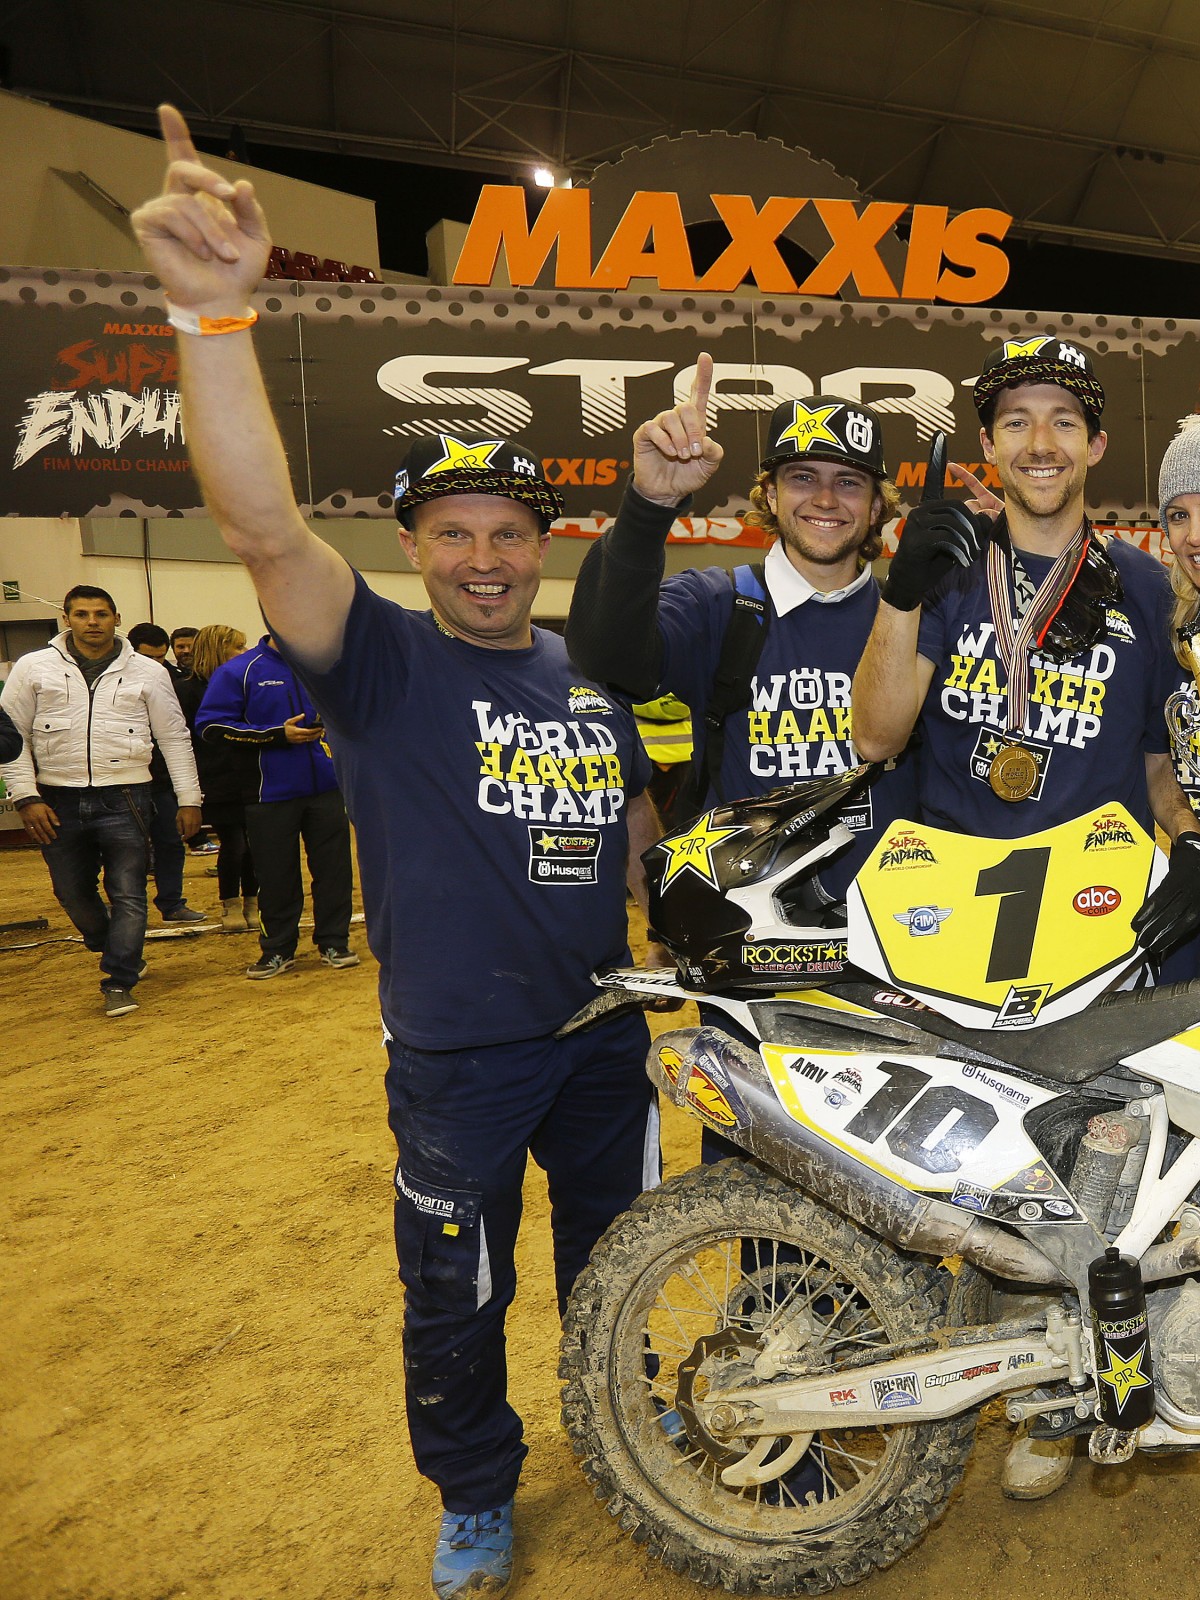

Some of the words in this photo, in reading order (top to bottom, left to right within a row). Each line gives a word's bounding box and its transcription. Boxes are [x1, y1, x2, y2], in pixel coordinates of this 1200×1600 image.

[453, 185, 1011, 302] MAXXIS
[103, 322, 174, 337] MAXXIS
[50, 339, 178, 393] SUPE
[377, 354, 985, 443] STAR
[12, 387, 185, 470] ENDU
[43, 458, 71, 471] FIM
[74, 459, 131, 472] WORLD
[735, 598, 764, 611] OGIO
[1106, 609, 1129, 624] UPER
[569, 686, 599, 698] SUPER
[944, 655, 1107, 716] HAKER
[567, 695, 613, 713] ENDURO
[749, 707, 853, 744] HAAK
[941, 687, 1101, 749] CHMP
[474, 742, 625, 792] HAAKER
[478, 776, 625, 825] CHAMP
[1092, 819, 1128, 832] SUPER
[888, 836, 928, 850] SUPER
[1083, 830, 1139, 852] ENDURO
[878, 848, 939, 871] ENDURO
[1077, 887, 1117, 909] abc
[914, 915, 934, 927] FIM
[975, 847, 1052, 984] 1
[752, 962, 801, 972] ENERGY
[807, 960, 842, 972] DRINK
[975, 1068, 1033, 1105] Husqvarna
[843, 1061, 999, 1174] 10
[400, 1179, 455, 1212] Husqvarna
[829, 1388, 857, 1402] RK
